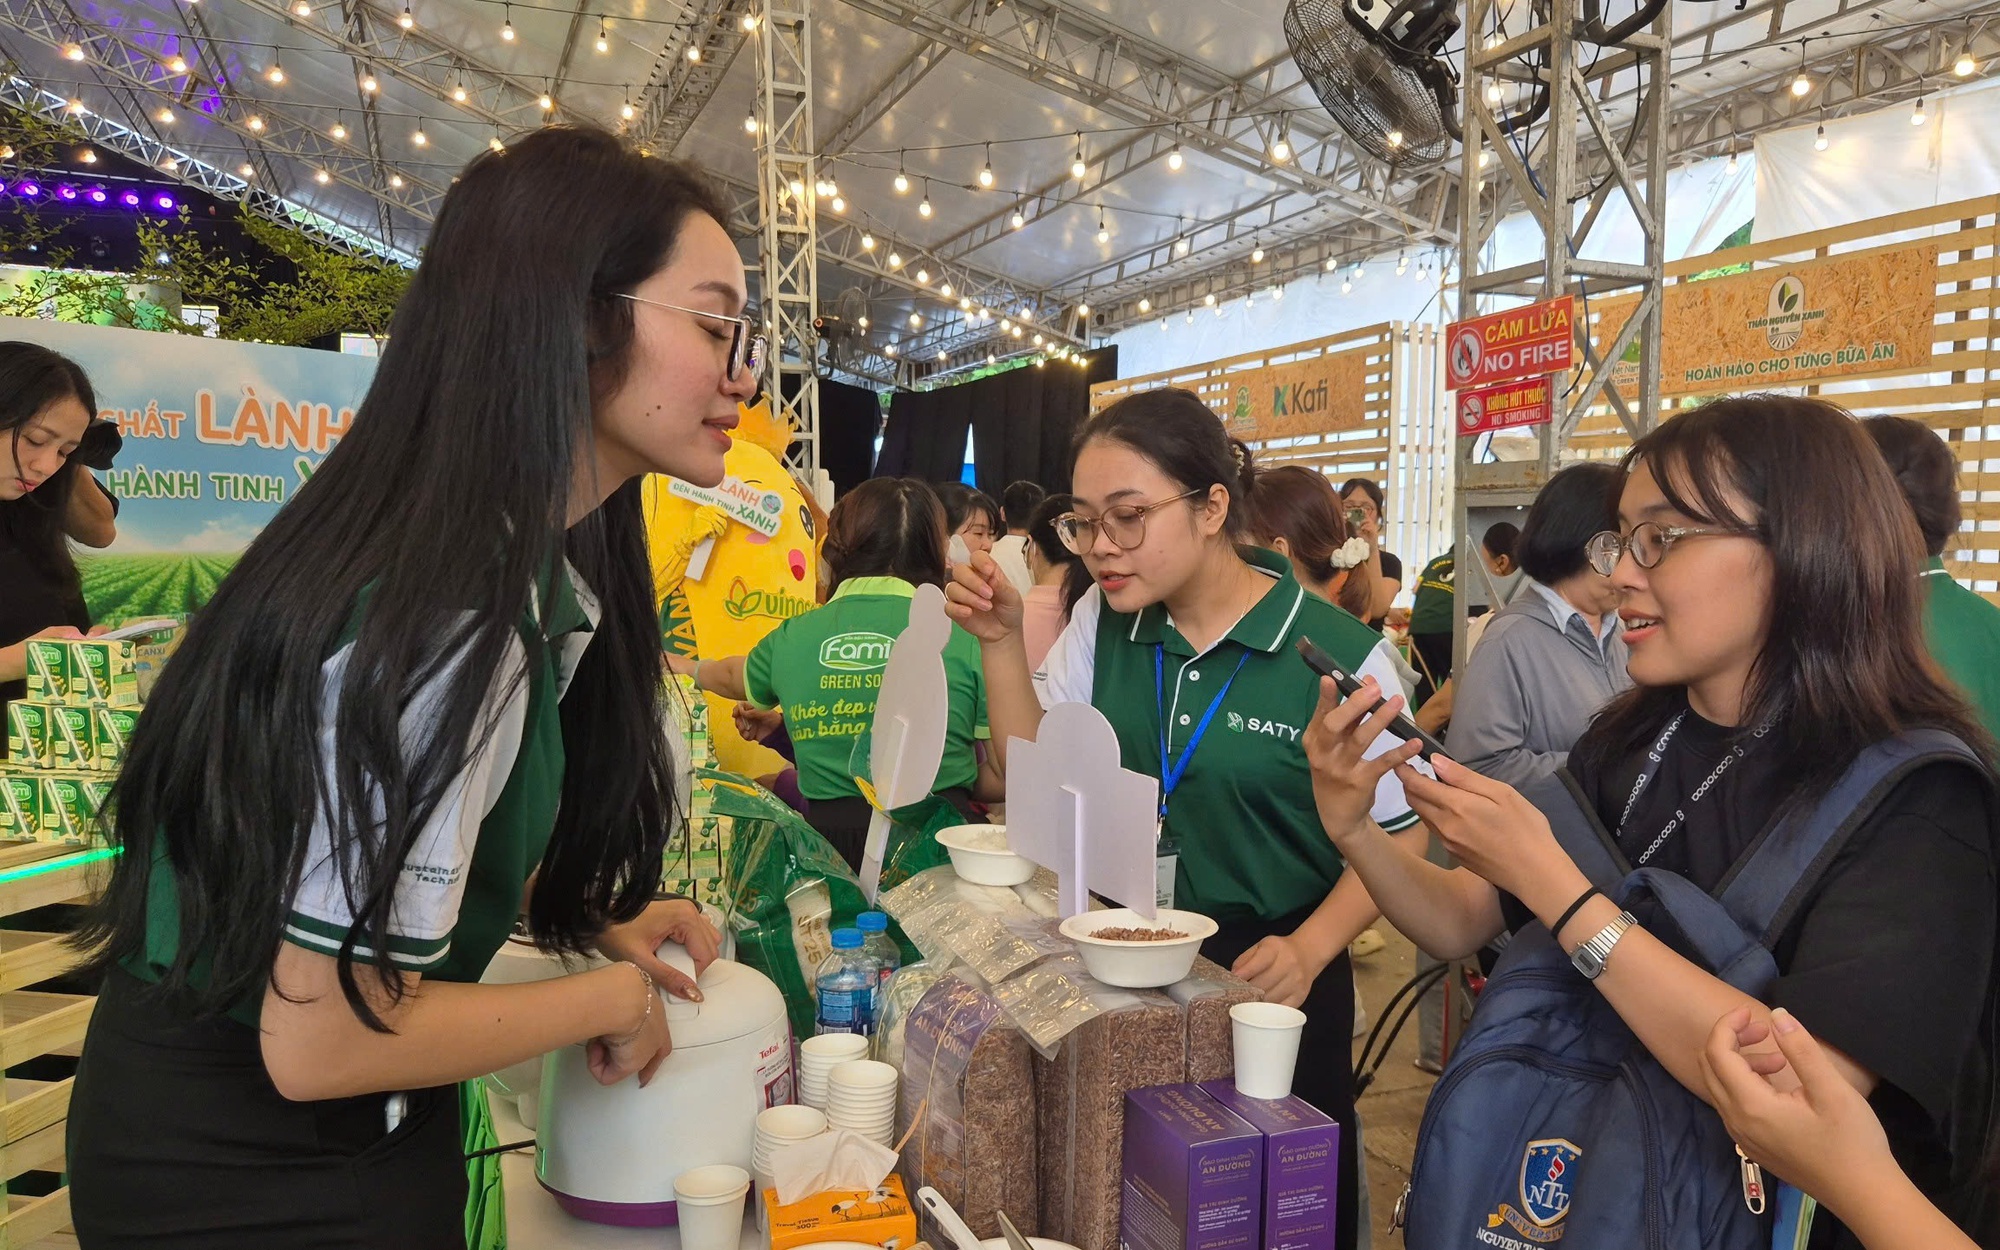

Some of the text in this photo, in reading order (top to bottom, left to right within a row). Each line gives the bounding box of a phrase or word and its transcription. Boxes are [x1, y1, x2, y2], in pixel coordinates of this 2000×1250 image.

[1801, 309, 1825, 321] XANH
[1484, 340, 1569, 374] NO FIRE
[1685, 341, 1896, 382] HOÀN HẢO CHO TỪNG BỮA ĂN
[1291, 378, 1328, 415] Kafi
[1491, 407, 1541, 426] NO SMOKING
[108, 465, 283, 502] HÀNH TINH
[736, 503, 777, 534] XANH
[820, 673, 884, 690] GREEN SO
[832, 698, 867, 719] đẹp
[1247, 717, 1301, 742] SATY
[759, 1042, 780, 1060] Tefal
[1202, 1166, 1216, 1175] AN
[1281, 1155, 1294, 1164] AN
[1527, 1180, 1569, 1211] NTT
